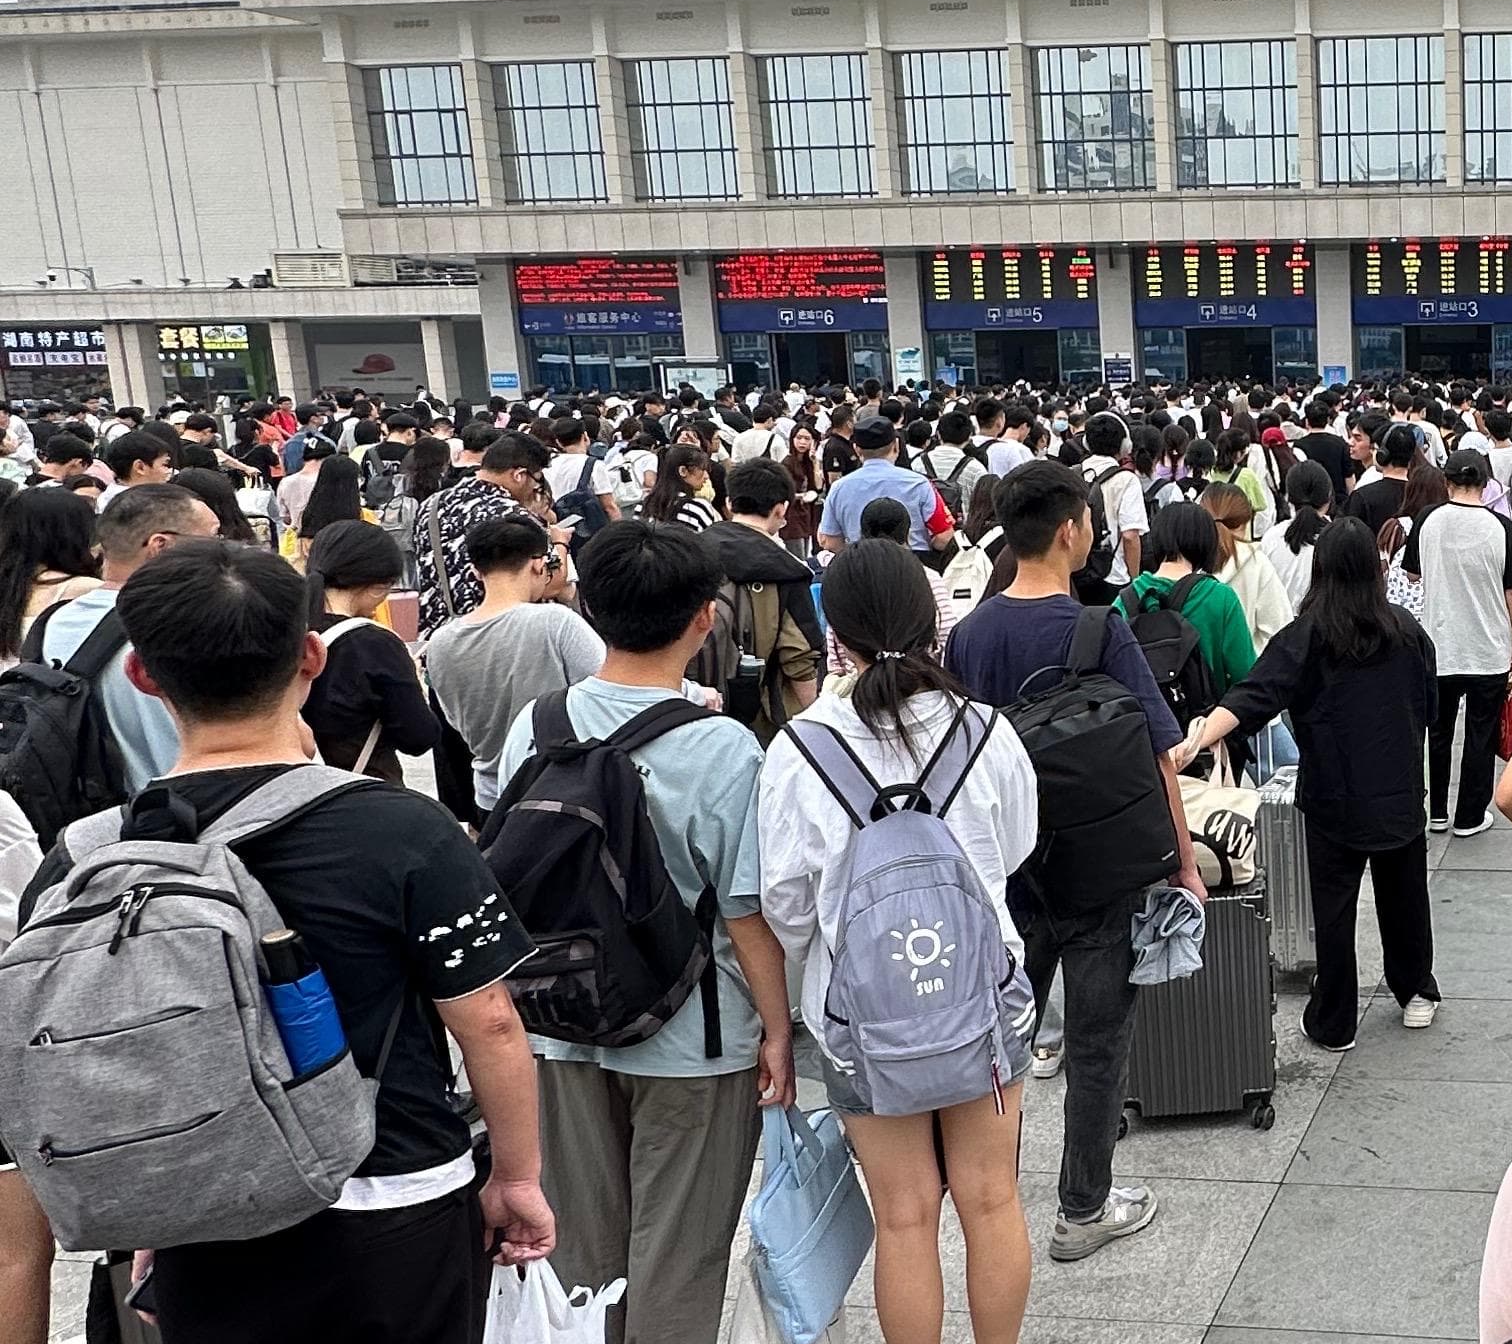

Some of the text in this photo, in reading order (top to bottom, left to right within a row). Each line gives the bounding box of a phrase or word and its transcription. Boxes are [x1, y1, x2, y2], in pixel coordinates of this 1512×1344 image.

[2, 330, 105, 347] 湖南特产超市
